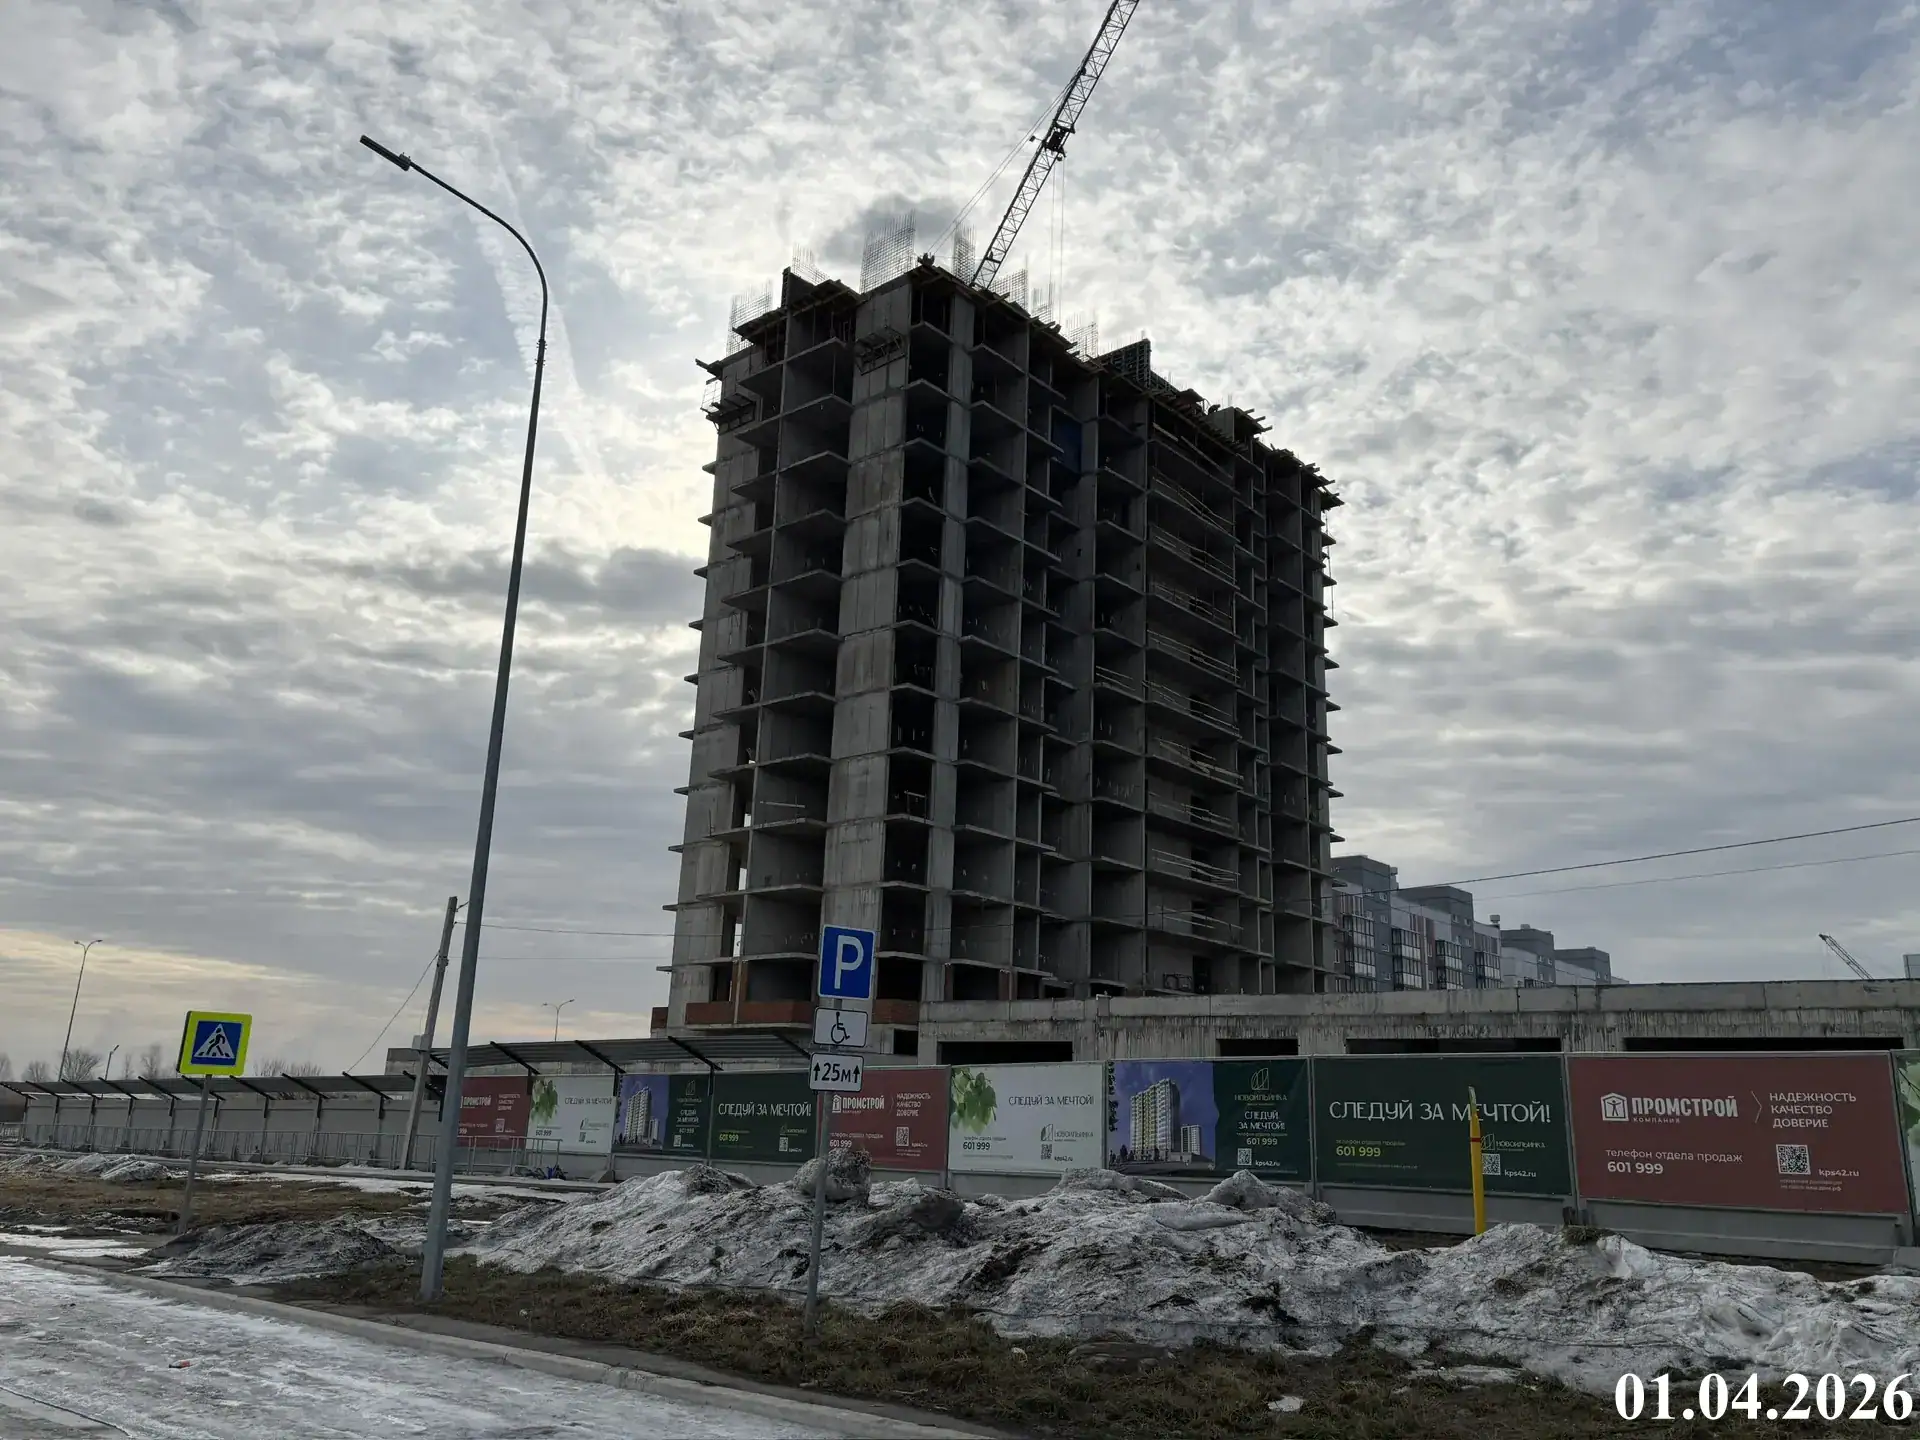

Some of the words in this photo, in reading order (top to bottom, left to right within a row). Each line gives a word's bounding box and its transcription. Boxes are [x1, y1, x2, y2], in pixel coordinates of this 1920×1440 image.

[834, 934, 864, 989] P
[842, 1095, 884, 1110] ПРОМСТРОЙ
[1008, 1094, 1042, 1106] СЛЕДУЙ
[1044, 1096, 1054, 1105] ЗА
[1770, 1092, 1856, 1103] НАДЕЖНОСТЬ
[718, 1102, 754, 1118] СЛЕДУЙ
[756, 1103, 767, 1116] ЗА
[770, 1102, 812, 1116] МЕЧТОЙ!
[1329, 1100, 1413, 1121] СЛЕДУЙ
[1420, 1103, 1444, 1121] ЗА
[1632, 1096, 1738, 1117] ПРОМСТРОЙ
[1771, 1105, 1833, 1114] КАЧЕСТВО
[1244, 1110, 1278, 1120] СЛЕДУЙ
[1772, 1118, 1829, 1128] ДОВЕРИЕ
[963, 1142, 975, 1150] 601
[976, 1142, 990, 1150] 999
[1336, 1146, 1356, 1156] 601
[1358, 1146, 1381, 1157] 999
[1606, 1149, 1652, 1160] телефон
[1656, 1151, 1694, 1161] отдела
[1697, 1153, 1743, 1163] продаж
[1504, 1169, 1536, 1177] kps42.ru
[1608, 1161, 1631, 1173] 601
[1636, 1162, 1664, 1174] 999
[1818, 1168, 1859, 1177] kps42.ru
